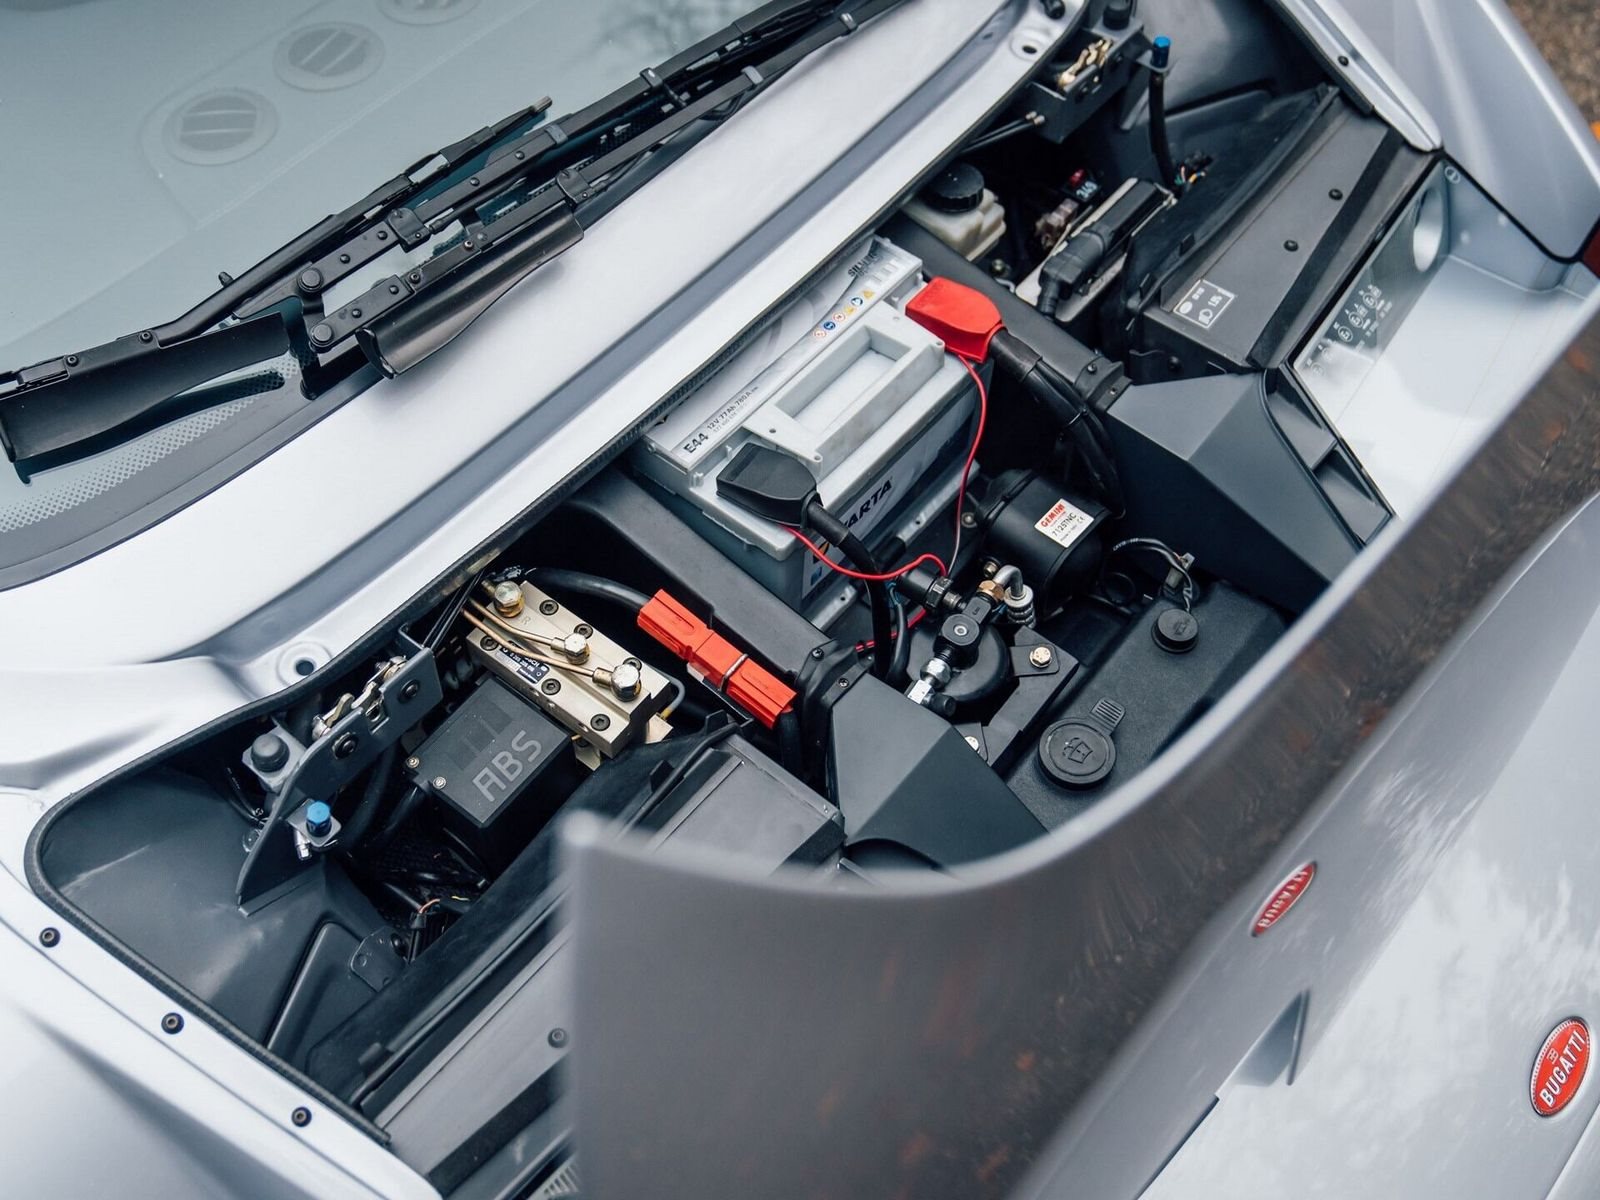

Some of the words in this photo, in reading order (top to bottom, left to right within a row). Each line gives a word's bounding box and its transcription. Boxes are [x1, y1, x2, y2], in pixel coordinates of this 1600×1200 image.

[683, 432, 709, 454] E44
[844, 479, 892, 528] ARTA
[1040, 503, 1066, 528] GEMINI
[472, 730, 542, 802] ABS
[1540, 1030, 1586, 1107] BUGATTI
